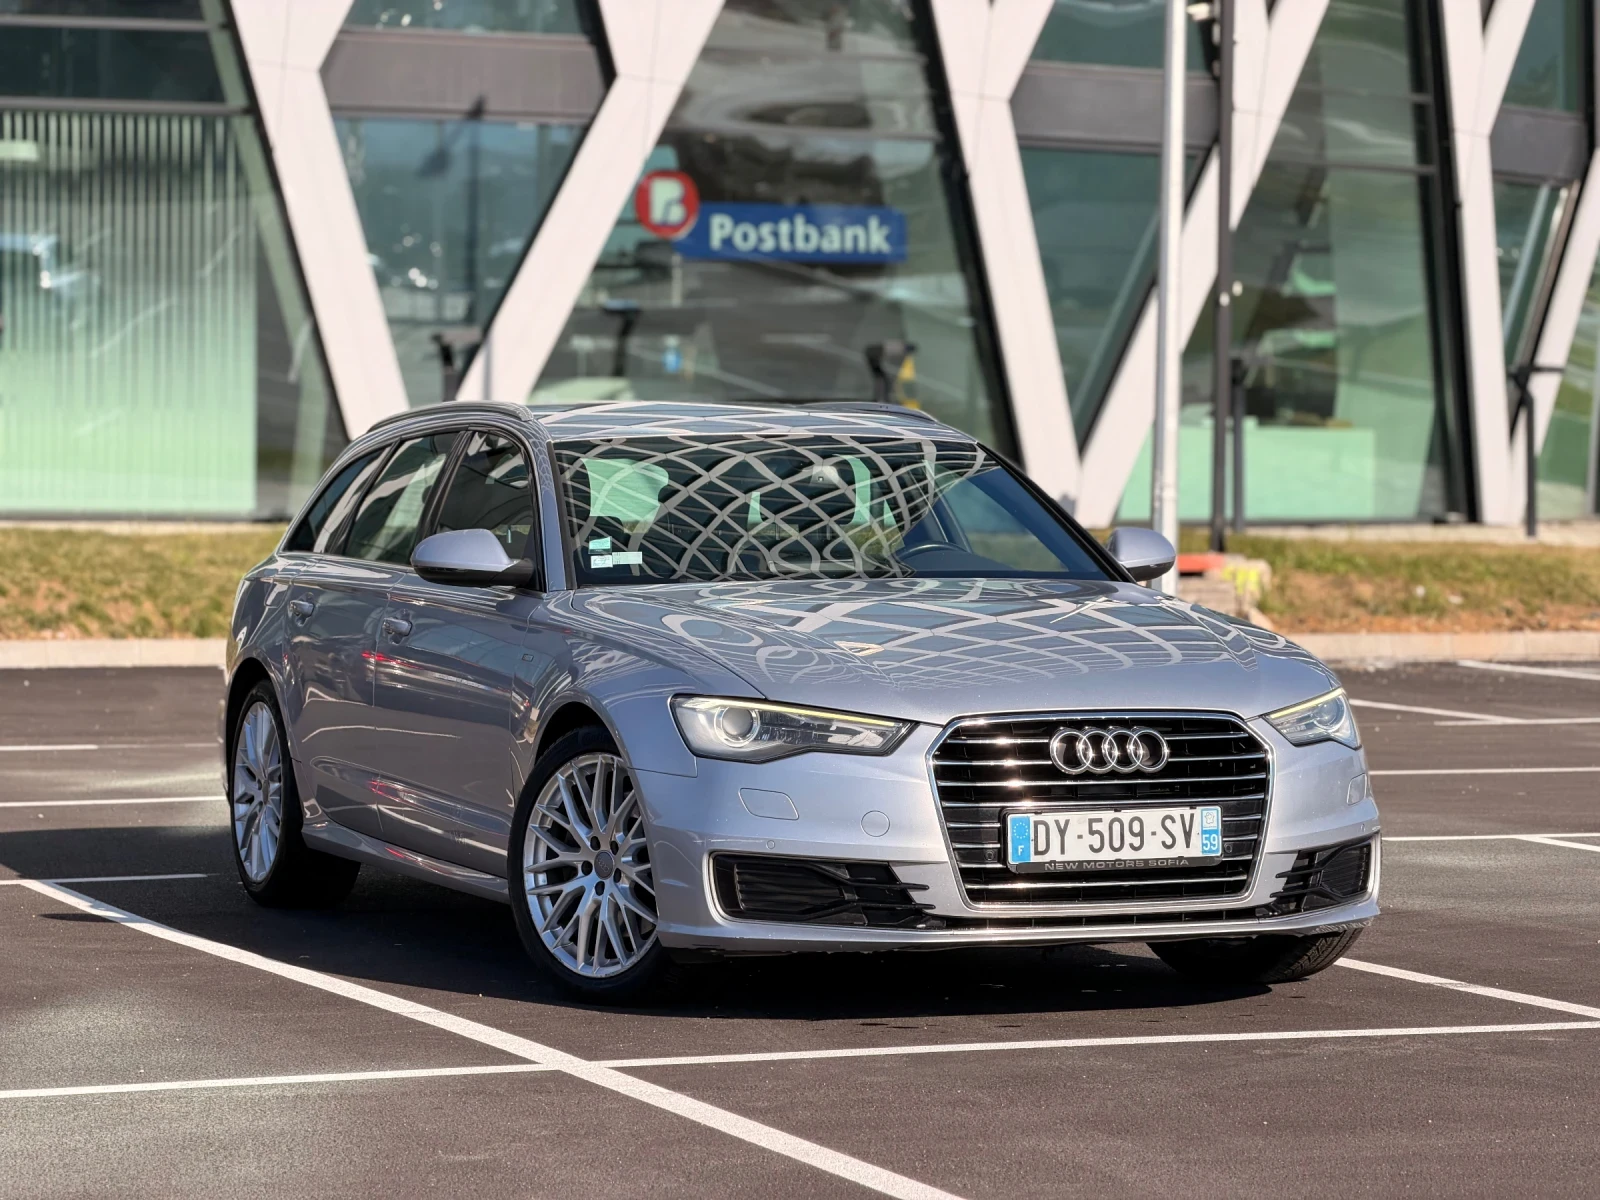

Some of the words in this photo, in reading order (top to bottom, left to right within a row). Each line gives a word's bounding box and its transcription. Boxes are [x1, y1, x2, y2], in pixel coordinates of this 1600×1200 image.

[709, 213, 890, 253] Postbank
[1033, 812, 1195, 856] DY-509-SV
[1202, 833, 1218, 851] 59
[1018, 845, 1025, 856] F
[1044, 862, 1079, 871] NEW
[1083, 859, 1144, 869] MOTORS
[1148, 858, 1189, 867] SOFIA
